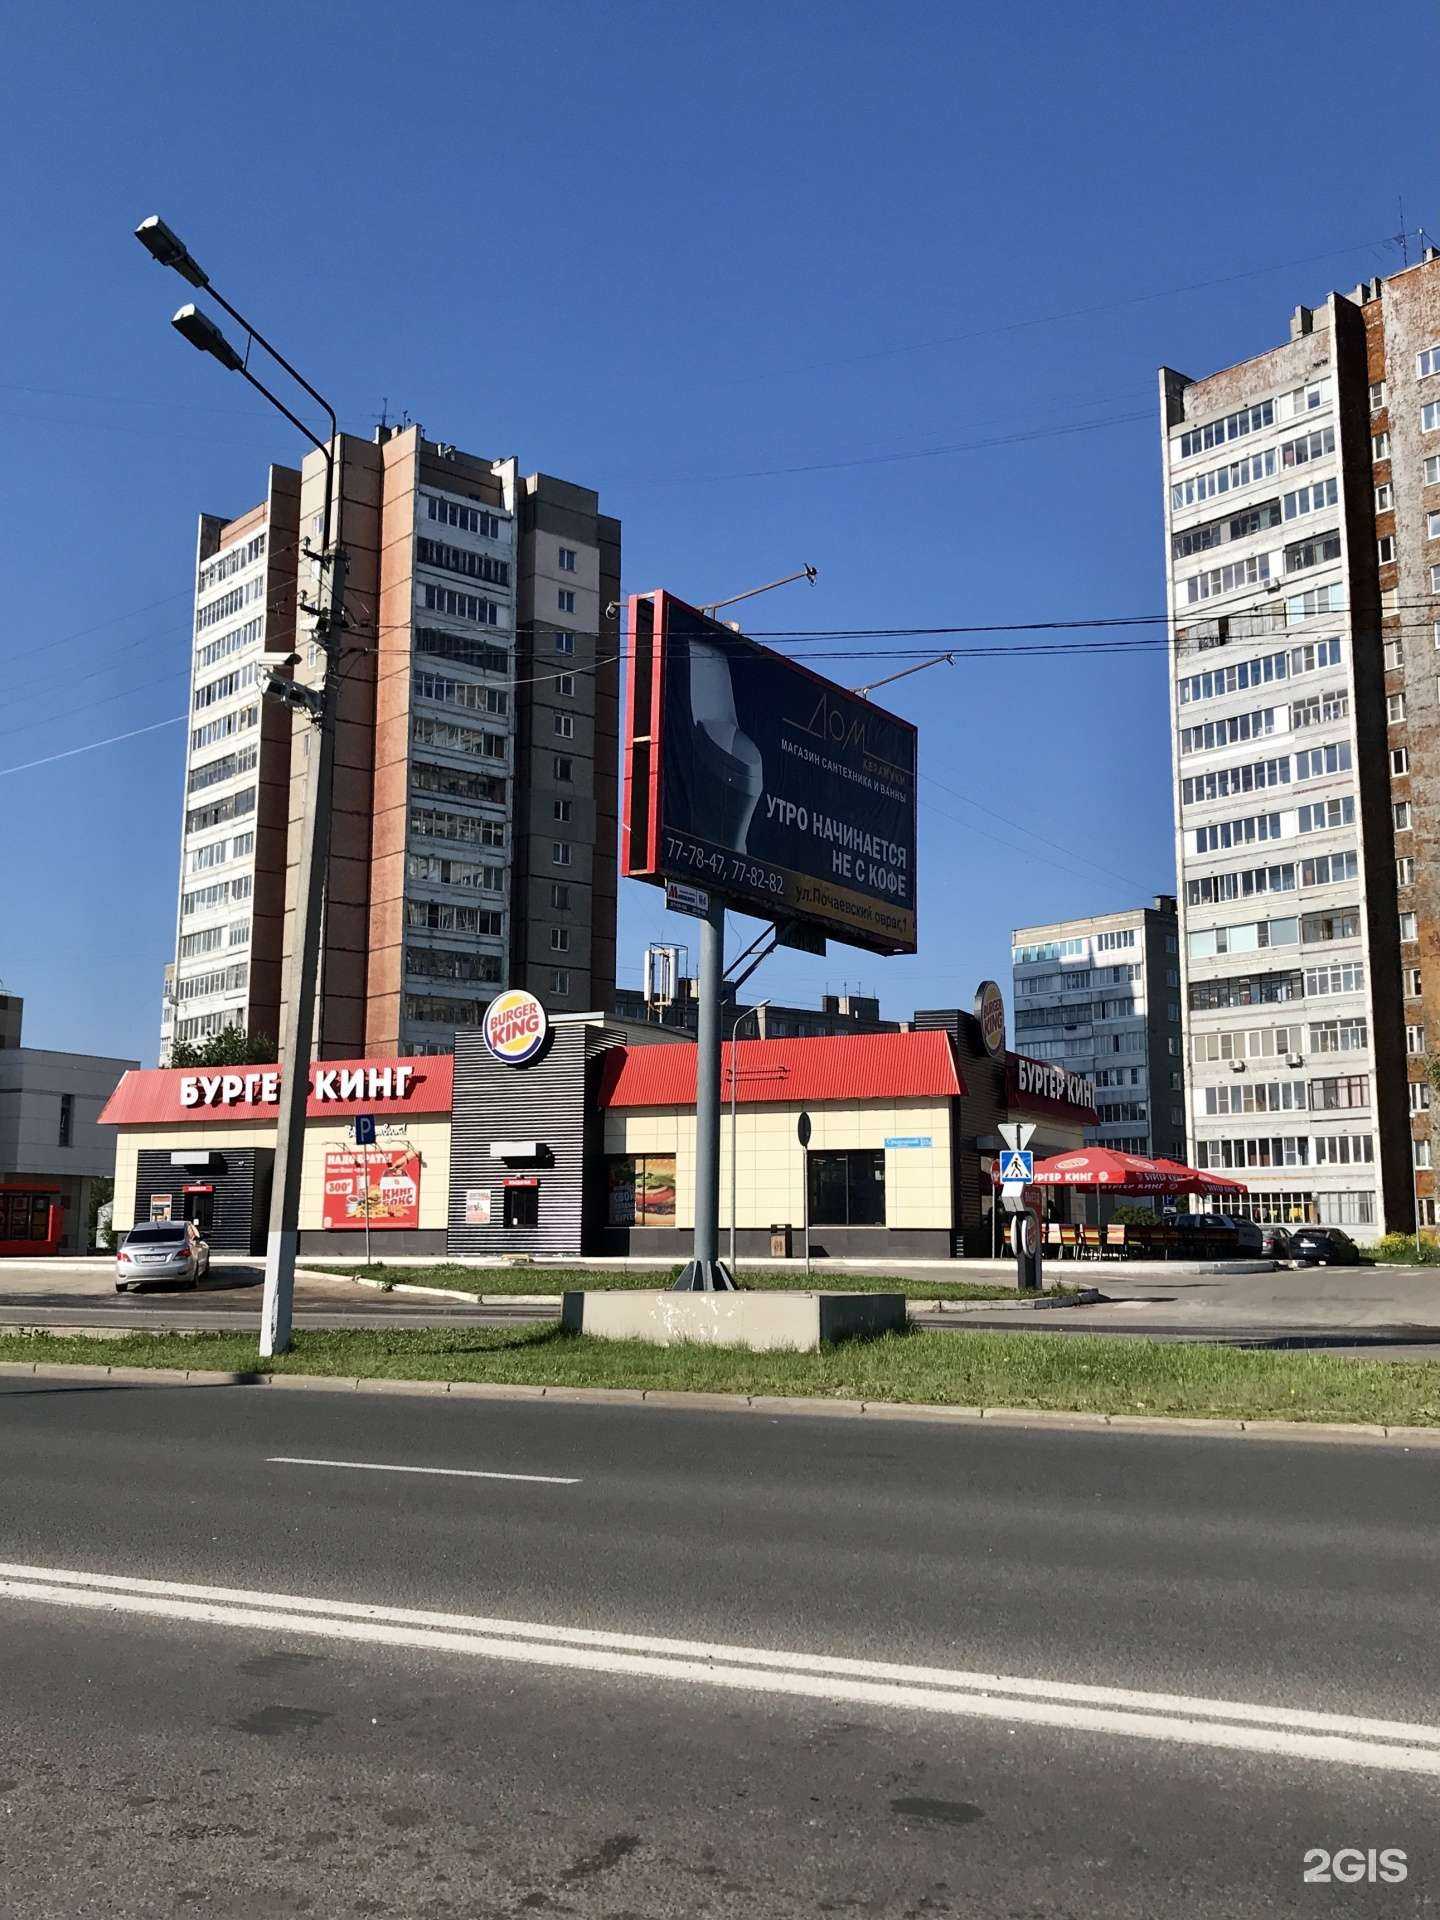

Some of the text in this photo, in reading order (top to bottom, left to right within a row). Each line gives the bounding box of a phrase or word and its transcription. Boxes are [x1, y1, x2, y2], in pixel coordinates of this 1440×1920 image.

[805, 692, 865, 752] ДОМ
[781, 738, 906, 803] МАГАЗИН САНТЕХНИКА И ВАННЫ
[766, 793, 907, 870] УТРО НАЧИНАЕТСЯ
[666, 837, 785, 895] 77-78-47, 77-82-82
[832, 850, 906, 897] НЕ С КОФЕ
[490, 1002, 538, 1031] BURGER
[492, 1015, 539, 1049] KING
[179, 1066, 413, 1106] БУРГЕ КИНГ
[1018, 1059, 1065, 1100] БУРГЕР
[382, 1187, 414, 1201] КИНГ
[1064, 1172, 1094, 1182] КИНГ
